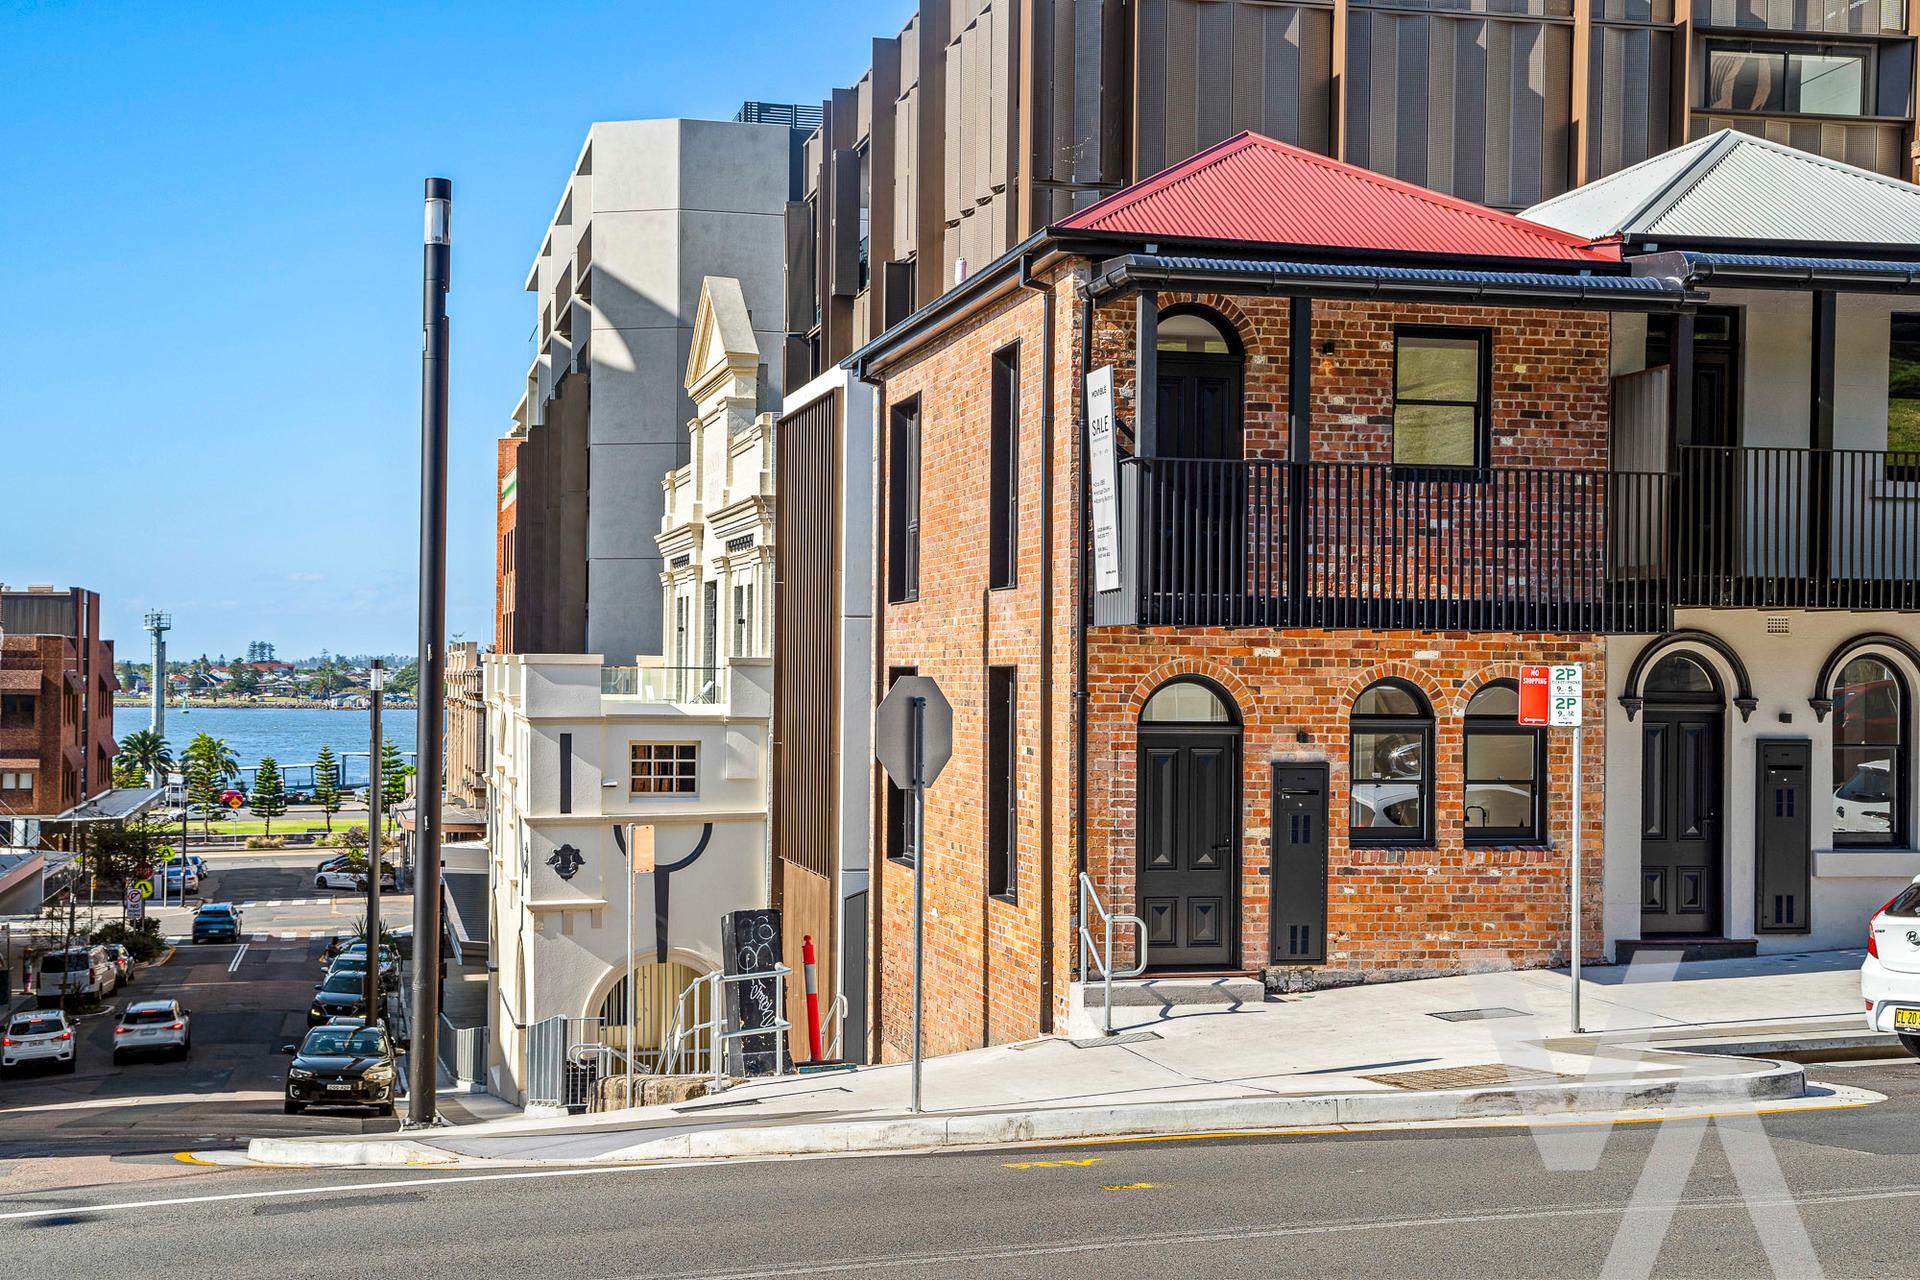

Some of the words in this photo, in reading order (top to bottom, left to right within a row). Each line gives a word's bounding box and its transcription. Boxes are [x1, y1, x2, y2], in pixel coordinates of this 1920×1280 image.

[1092, 415, 1109, 437] SALE
[1555, 668, 1576, 680] 2P
[1555, 698, 1576, 710] 2P
